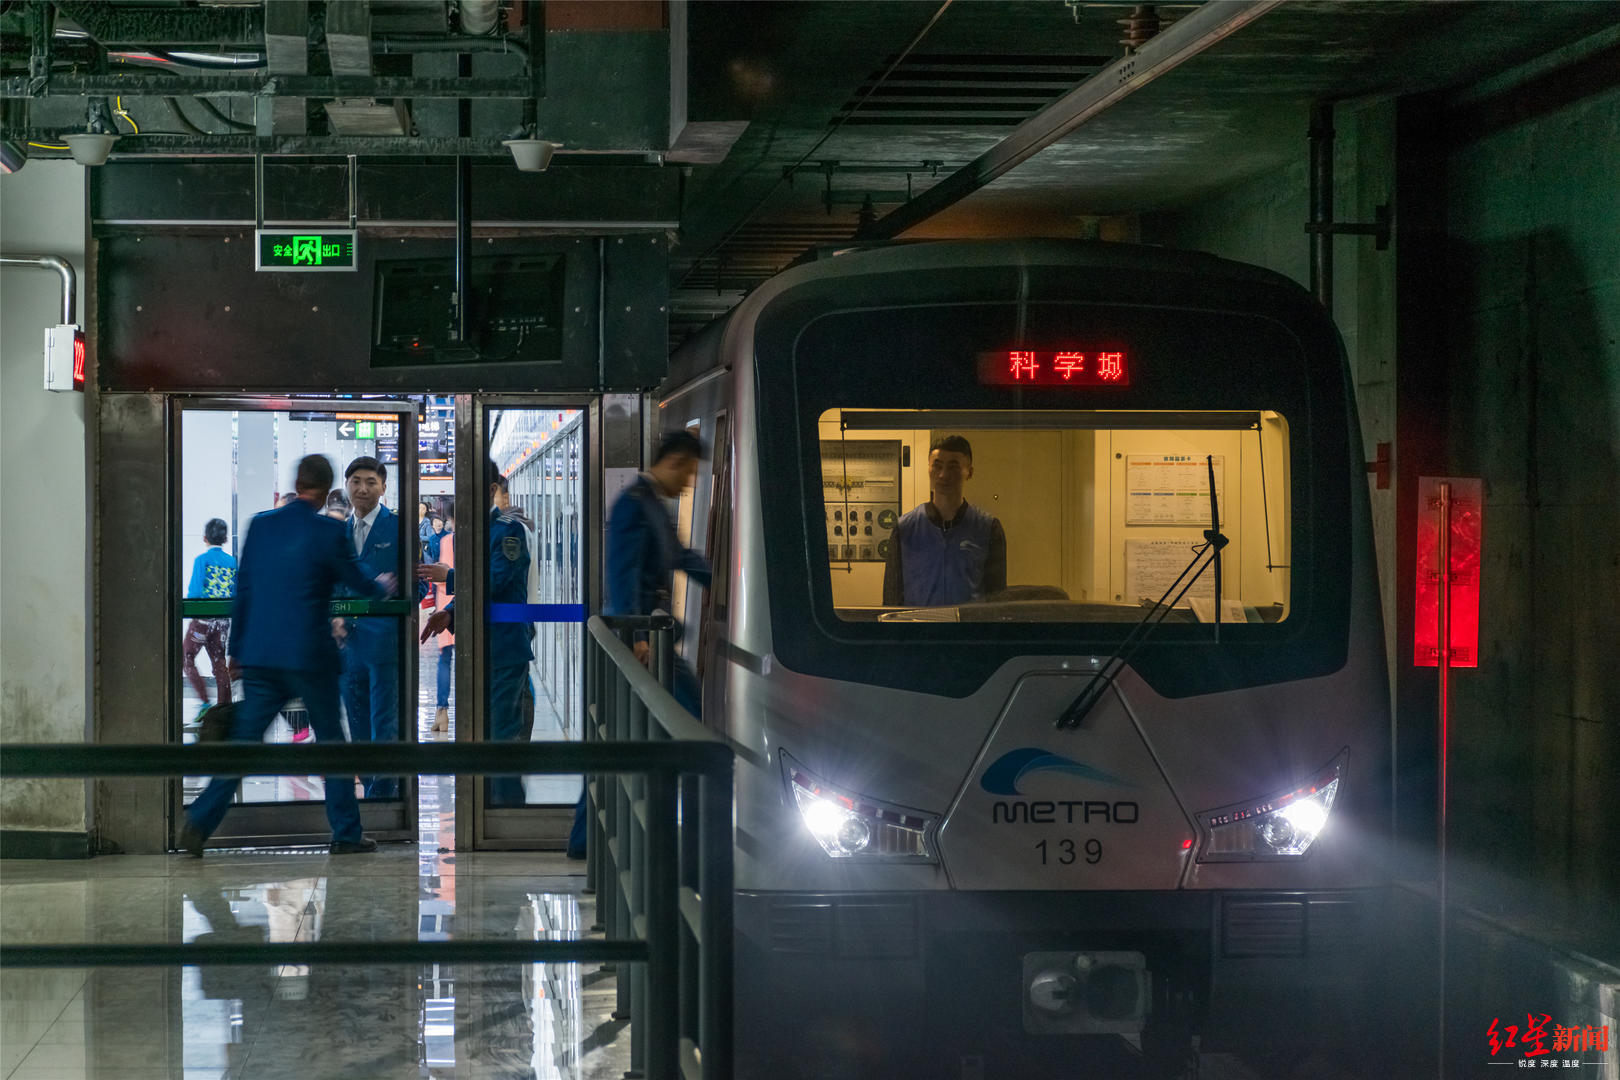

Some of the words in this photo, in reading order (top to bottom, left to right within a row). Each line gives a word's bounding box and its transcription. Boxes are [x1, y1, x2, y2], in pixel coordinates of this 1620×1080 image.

[273, 244, 293, 257] 安全
[322, 244, 340, 257] 出口
[1010, 351, 1122, 380] 科学城
[1035, 838, 1103, 865] 139
